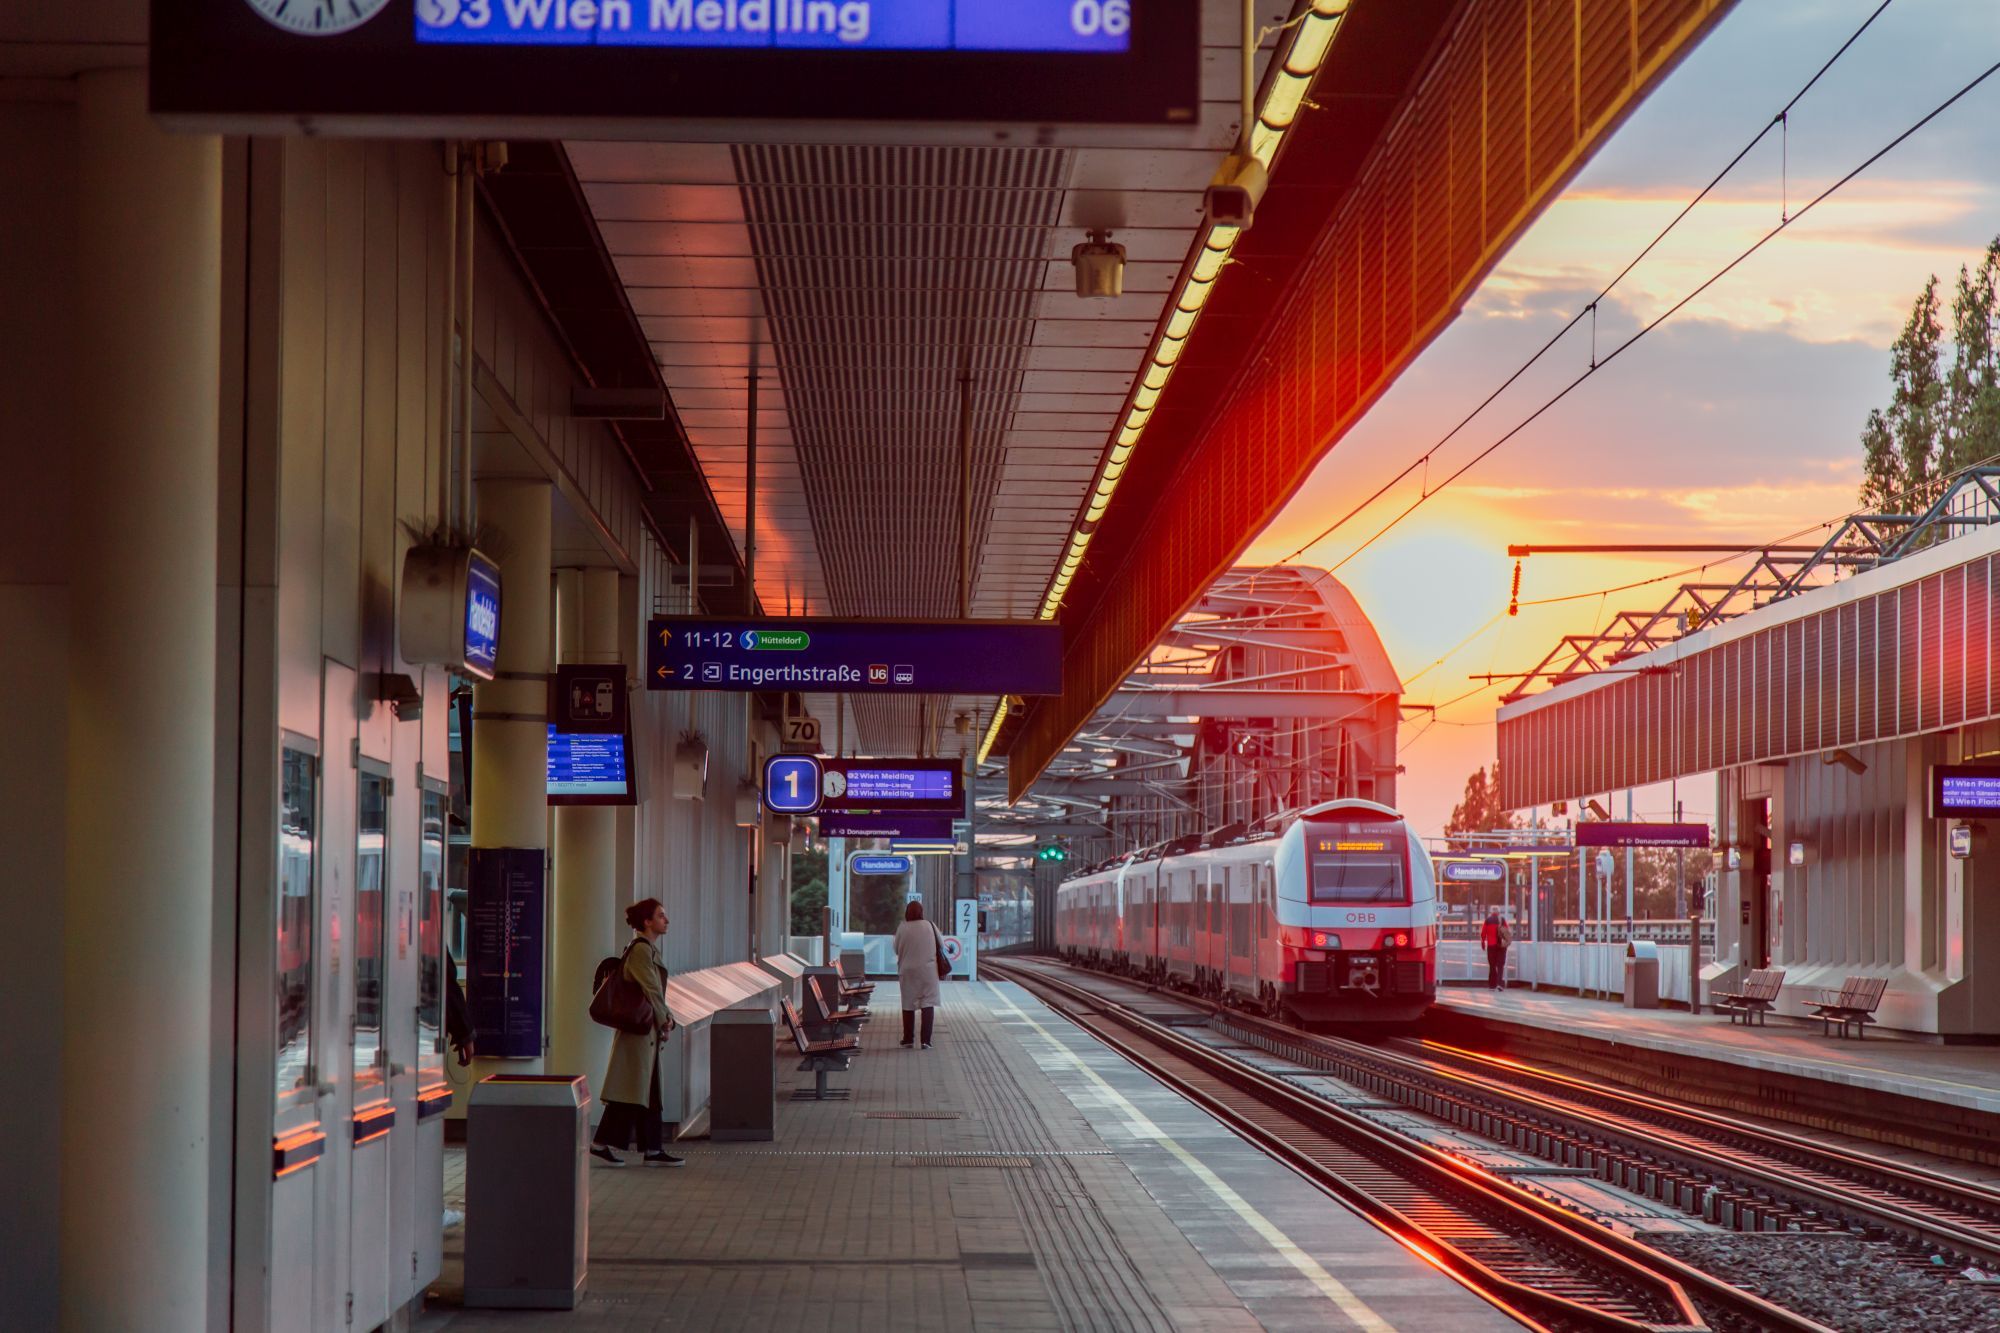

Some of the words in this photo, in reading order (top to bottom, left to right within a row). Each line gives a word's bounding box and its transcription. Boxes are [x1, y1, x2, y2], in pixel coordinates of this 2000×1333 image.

[504, 0, 631, 29] Wien
[649, 0, 870, 42] Meidling
[1072, 0, 1131, 36] 06
[684, 631, 733, 648] 11-12
[761, 636, 802, 645] Hütteldorf
[683, 663, 694, 680] 2
[729, 664, 861, 685] Engerthstraße
[870, 668, 887, 680] U6
[789, 721, 815, 740] 70
[860, 772, 880, 780] Wien
[881, 772, 915, 781] Meidling
[784, 770, 798, 798] 1
[881, 790, 915, 798] Meidling
[847, 828, 900, 836] Donaupromenade
[1634, 837, 1690, 845] Donaupromenade
[861, 861, 902, 869] Handelskai
[1455, 867, 1495, 875] Handelskai
